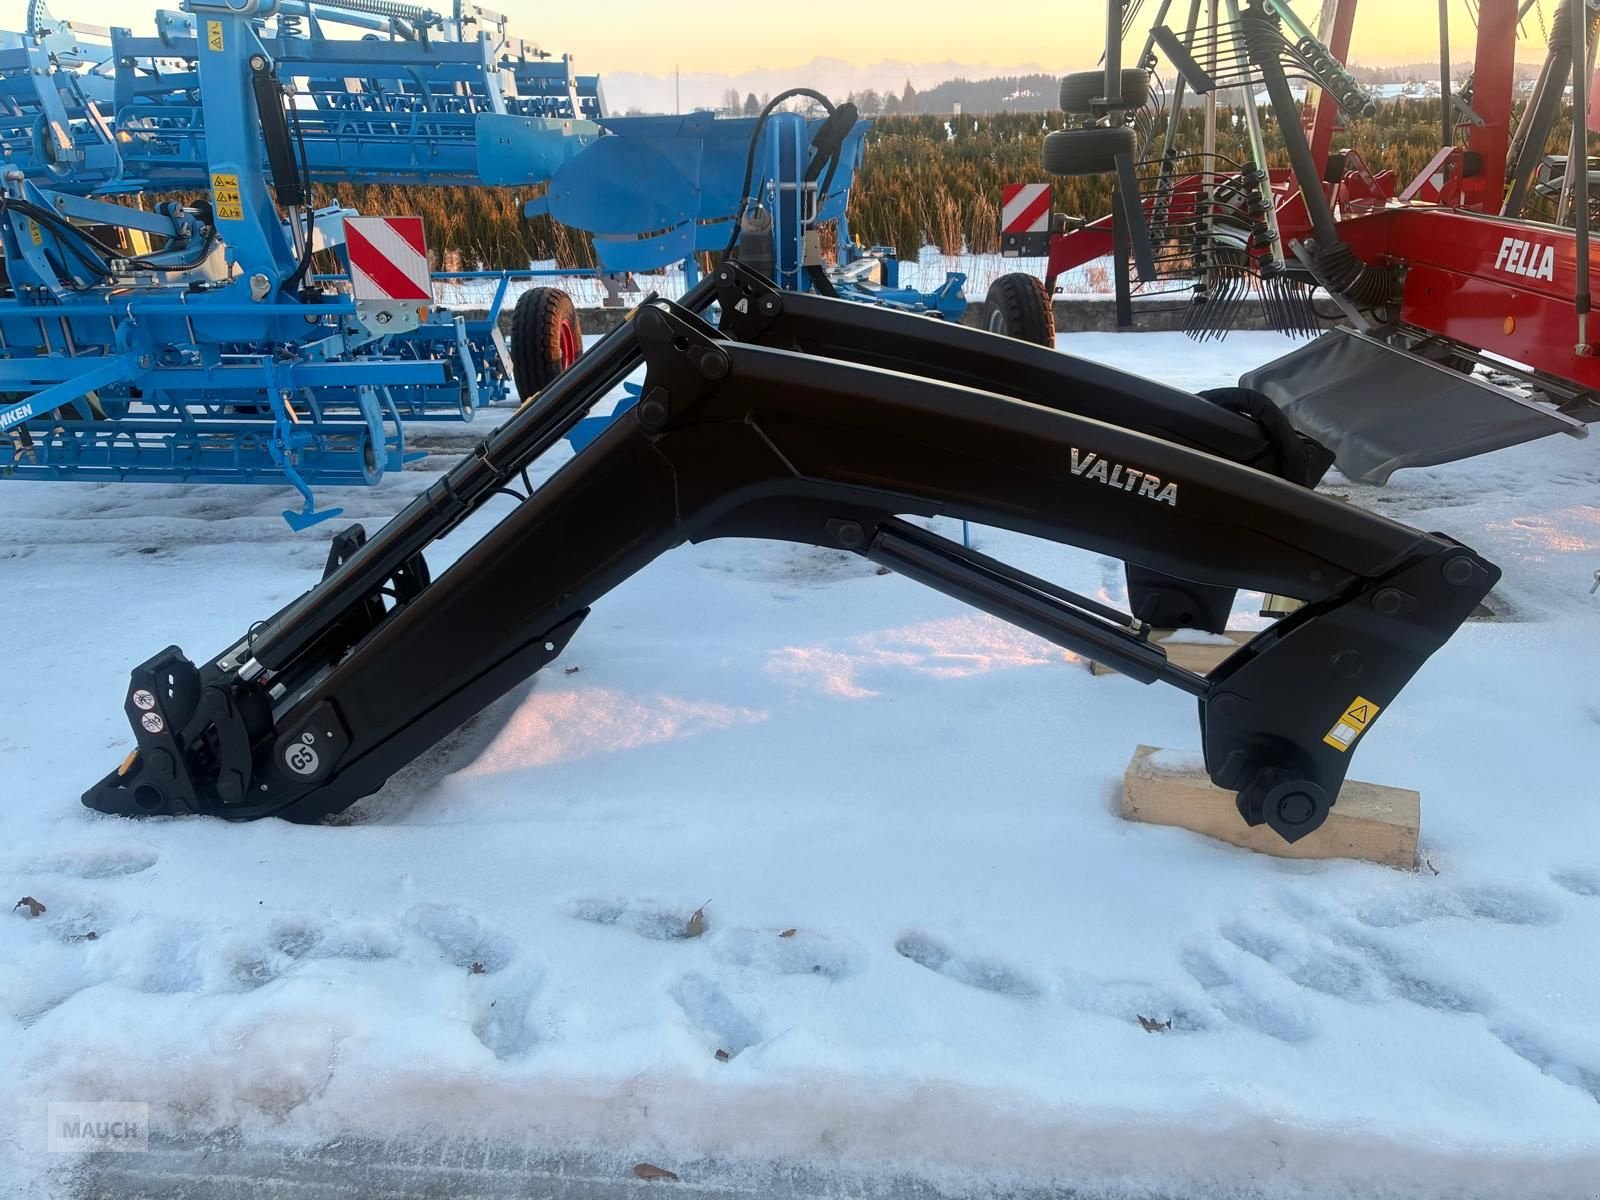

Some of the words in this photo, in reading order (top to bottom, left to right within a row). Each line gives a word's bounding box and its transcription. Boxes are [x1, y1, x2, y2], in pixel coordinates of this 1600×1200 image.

[1494, 237, 1554, 282] FELLA
[1071, 447, 1178, 507] VALTRA
[290, 746, 314, 771] G5
